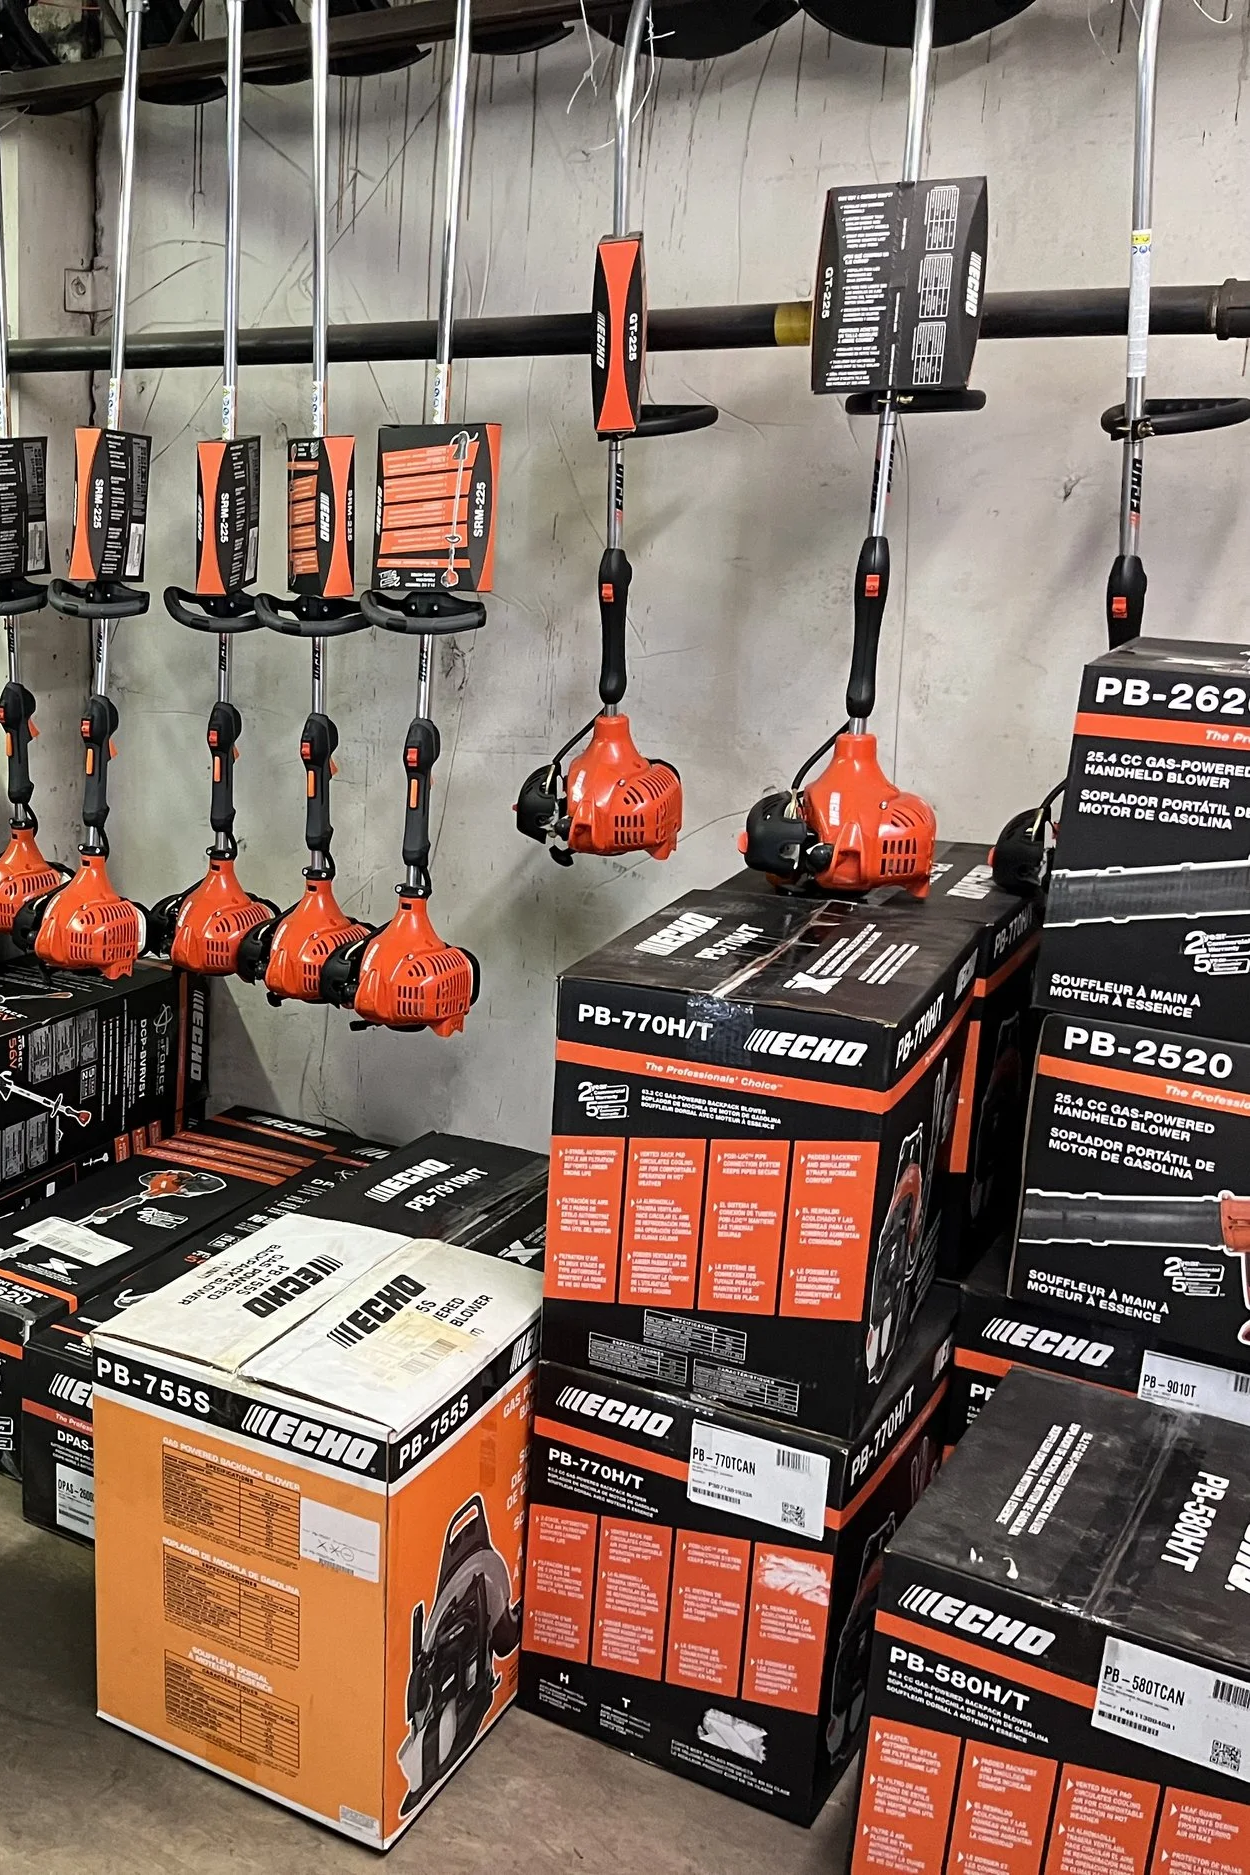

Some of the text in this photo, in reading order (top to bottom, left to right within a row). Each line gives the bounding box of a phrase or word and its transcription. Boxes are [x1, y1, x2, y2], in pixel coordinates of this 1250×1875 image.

[821, 267, 833, 319] GT-225
[965, 251, 982, 318] ECHO
[596, 310, 606, 369] ECHO
[628, 313, 638, 361] GT-225
[93, 479, 104, 529] SRM-225
[320, 491, 330, 543] ECHO
[473, 481, 486, 538] SRM-225
[1129, 458, 1143, 526] ECHO
[220, 492, 230, 544] SRM-225
[1095, 676, 1250, 716] PB-262
[1084, 763, 1231, 790] HANDHELD BLOWER
[1086, 750, 1250, 779] 25.4 CC GAS-POWERED
[1078, 801, 1234, 831] MOTOR DE GASOLINA
[1080, 788, 1250, 819] SOPLADOR PORTÁTIL DE
[634, 912, 719, 957] ECHO
[1049, 985, 1194, 1020] MOTEUR À ESSENCE
[1051, 972, 1202, 1008] SOUFFLEUR À MAIN À
[190, 989, 206, 1082] ECHO
[577, 1003, 714, 1042] PB-770H/T
[743, 1027, 869, 1068] ECHO
[895, 996, 946, 1070] PB-770H/T
[8, 1037, 18, 1070] 56V
[138, 1018, 148, 1099] DCP-BVRVS1
[645, 1061, 665, 1073] The
[666, 1064, 739, 1084] Professionals'
[1062, 1025, 1234, 1080] PB-2520
[1055, 1092, 1216, 1135] 25.4 CC GAS-POWERED
[1165, 1083, 1189, 1099] The
[1053, 1103, 1192, 1143] HANDHELD BLOWER
[1048, 1137, 1194, 1181] MOTOR DE GASOLINA
[1049, 1126, 1217, 1173] SOPLADOR PORTÁTIL DE
[364, 1158, 452, 1203] ECHO
[405, 1167, 489, 1213] PB-7910H/T
[178, 1243, 282, 1306] BACKPACK BLOWER
[207, 1254, 285, 1301] GAS POWERED
[235, 1264, 290, 1296] PB-755S
[243, 1253, 344, 1319] ECHO
[327, 1274, 428, 1350] ECHO
[449, 1294, 493, 1328] BLOWER
[981, 1316, 1116, 1369] ECHO
[97, 1355, 211, 1416] PB-755S
[399, 1392, 470, 1471] PB-755S
[555, 1384, 675, 1439] ECHO
[850, 1386, 917, 1486] PB-770H/T
[163, 1436, 301, 1492] GAS POWERED BACKPACK BLOWER
[242, 1403, 380, 1475] ECHO
[548, 1447, 645, 1491] PB-770H/T
[1160, 1470, 1231, 1574] PB-580H/T
[897, 1583, 1057, 1657] ECHO
[889, 1645, 1031, 1713] PB-580H/T
[887, 1677, 1050, 1745] SOPLADOR DE MOCHILA DE MOTOR DE GASOLINA
